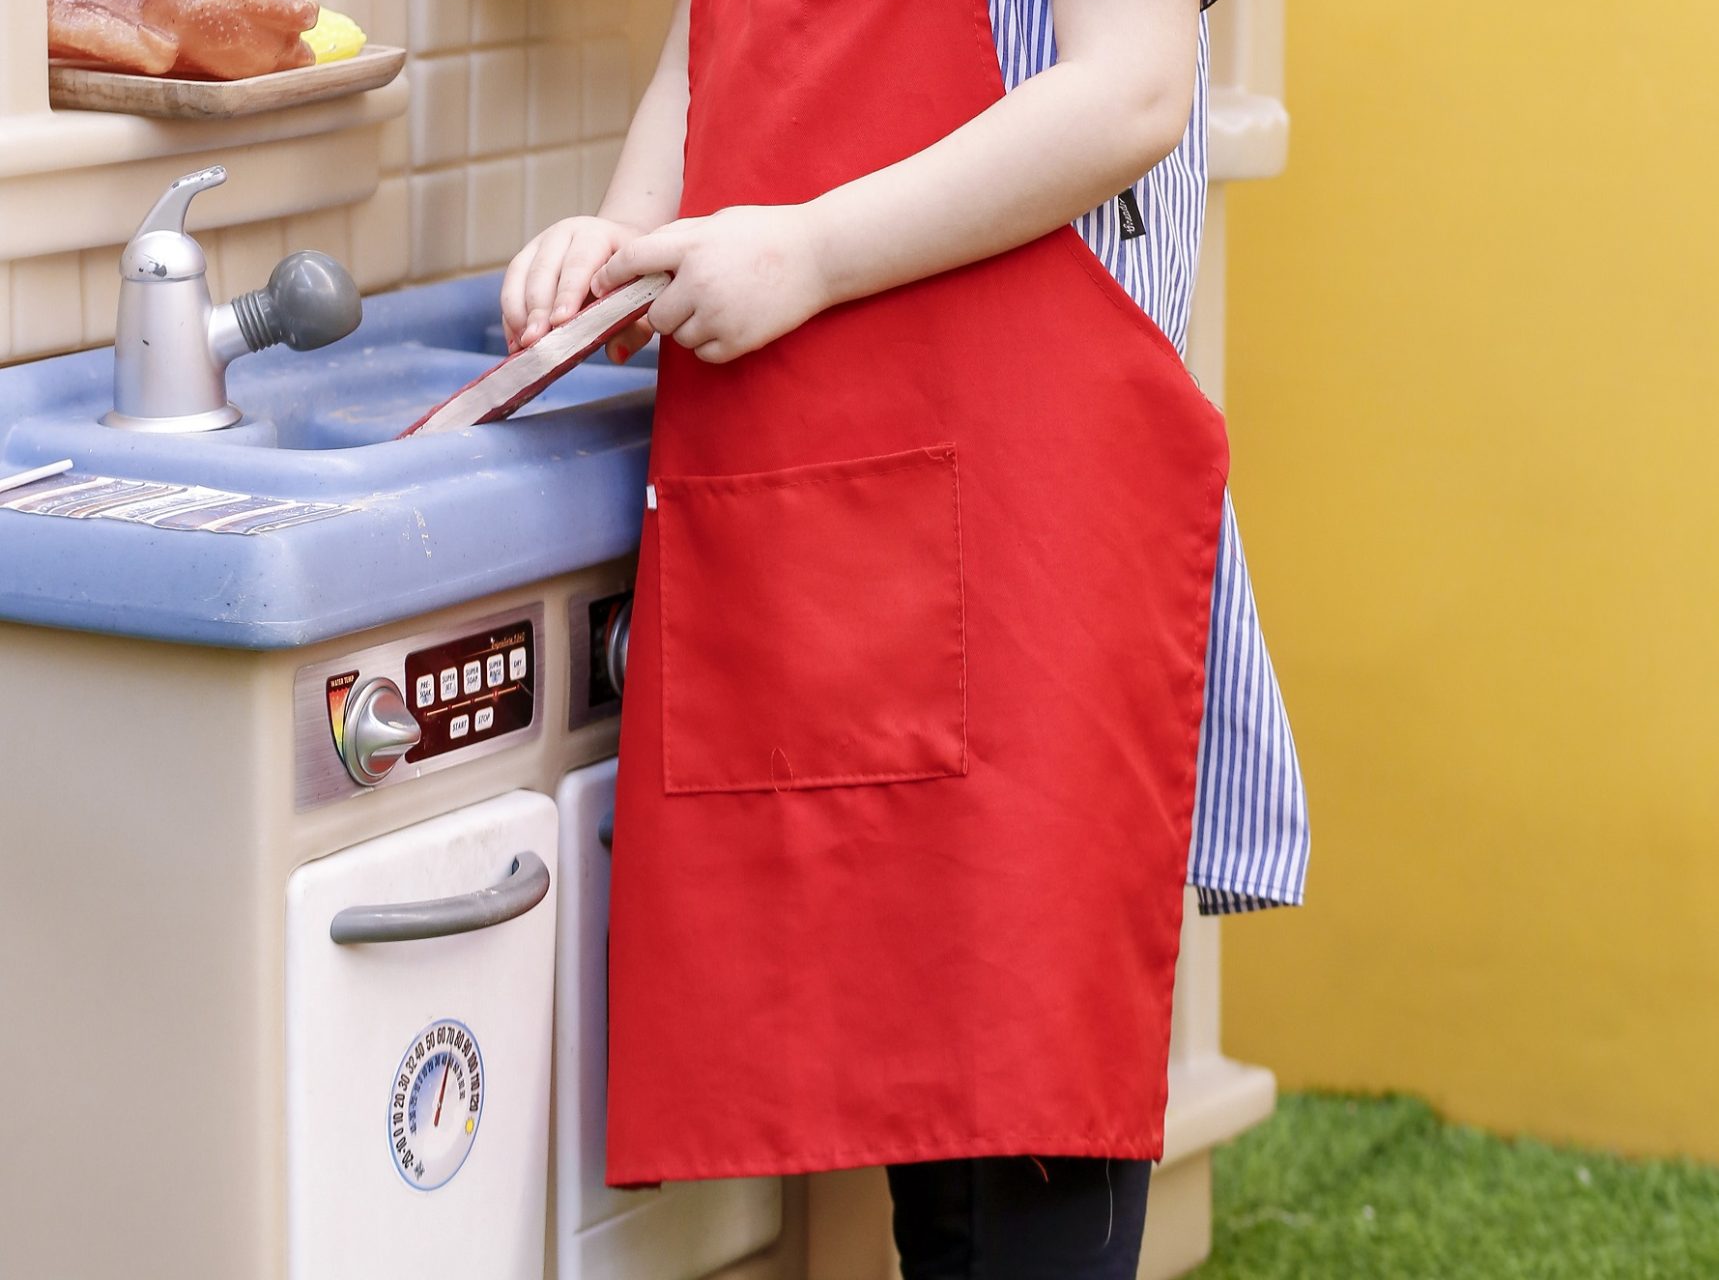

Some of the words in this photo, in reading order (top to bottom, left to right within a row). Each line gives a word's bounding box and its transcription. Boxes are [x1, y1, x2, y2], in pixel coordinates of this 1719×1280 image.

[465, 666, 479, 677] SUPER
[513, 659, 522, 668] DRY
[330, 677, 344, 687] WATER
[344, 675, 355, 684] TEMP
[442, 673, 455, 684] SUPER
[452, 719, 467, 732] START
[476, 712, 490, 725] STOP
[425, 1031, 436, 1051] 50
[436, 1026, 446, 1045] 60
[446, 1026, 455, 1045] 70
[454, 1029, 465, 1050] 80
[414, 1041, 425, 1060] 40
[461, 1038, 473, 1057] 90
[405, 1055, 417, 1074] 32
[467, 1051, 479, 1074] 100
[398, 1073, 410, 1091] 30
[470, 1072, 480, 1092] 110
[393, 1093, 405, 1108] 20
[469, 1092, 480, 1112] 120
[393, 1112, 404, 1126] 10
[393, 1127, 404, 1138] 0
[396, 1136, 407, 1153] -10
[402, 1149, 414, 1169] -20
